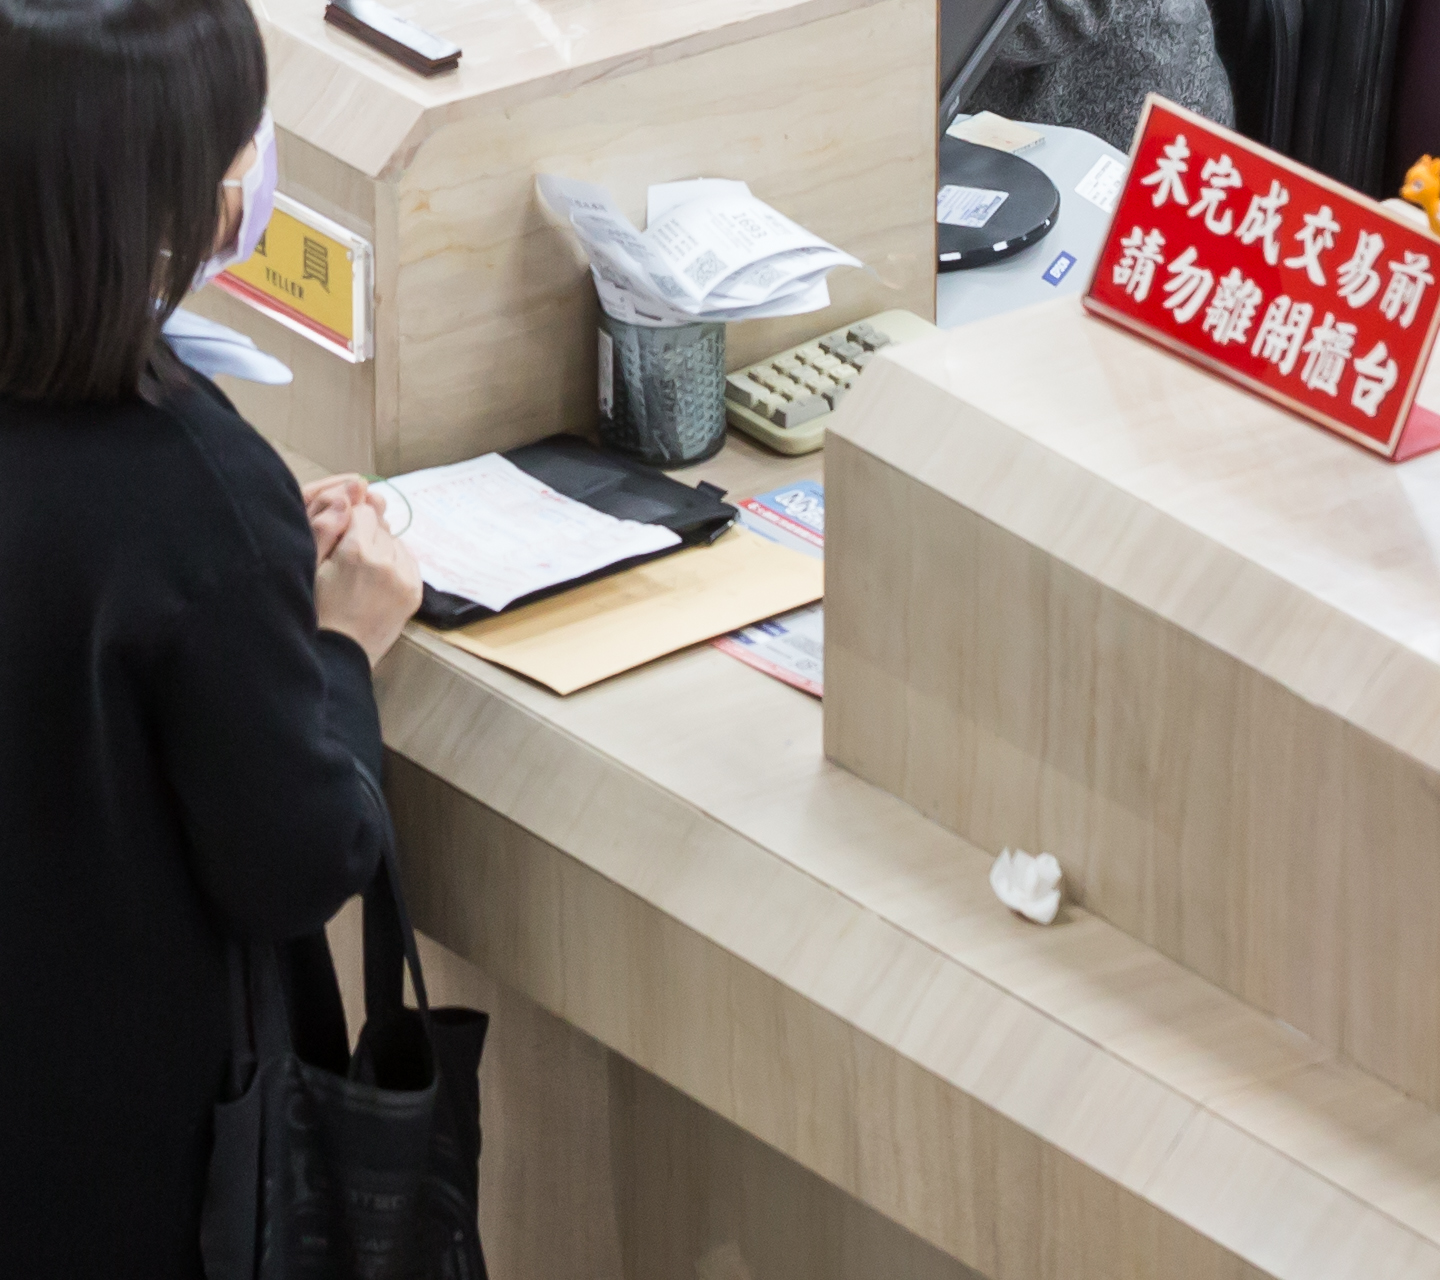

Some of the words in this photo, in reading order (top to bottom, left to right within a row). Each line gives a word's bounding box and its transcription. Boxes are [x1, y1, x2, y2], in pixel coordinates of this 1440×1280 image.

[265, 266, 305, 301] TELLER
[1112, 225, 1399, 418] 請勿離開櫃台
[1141, 134, 1435, 329] 未完成交易前
